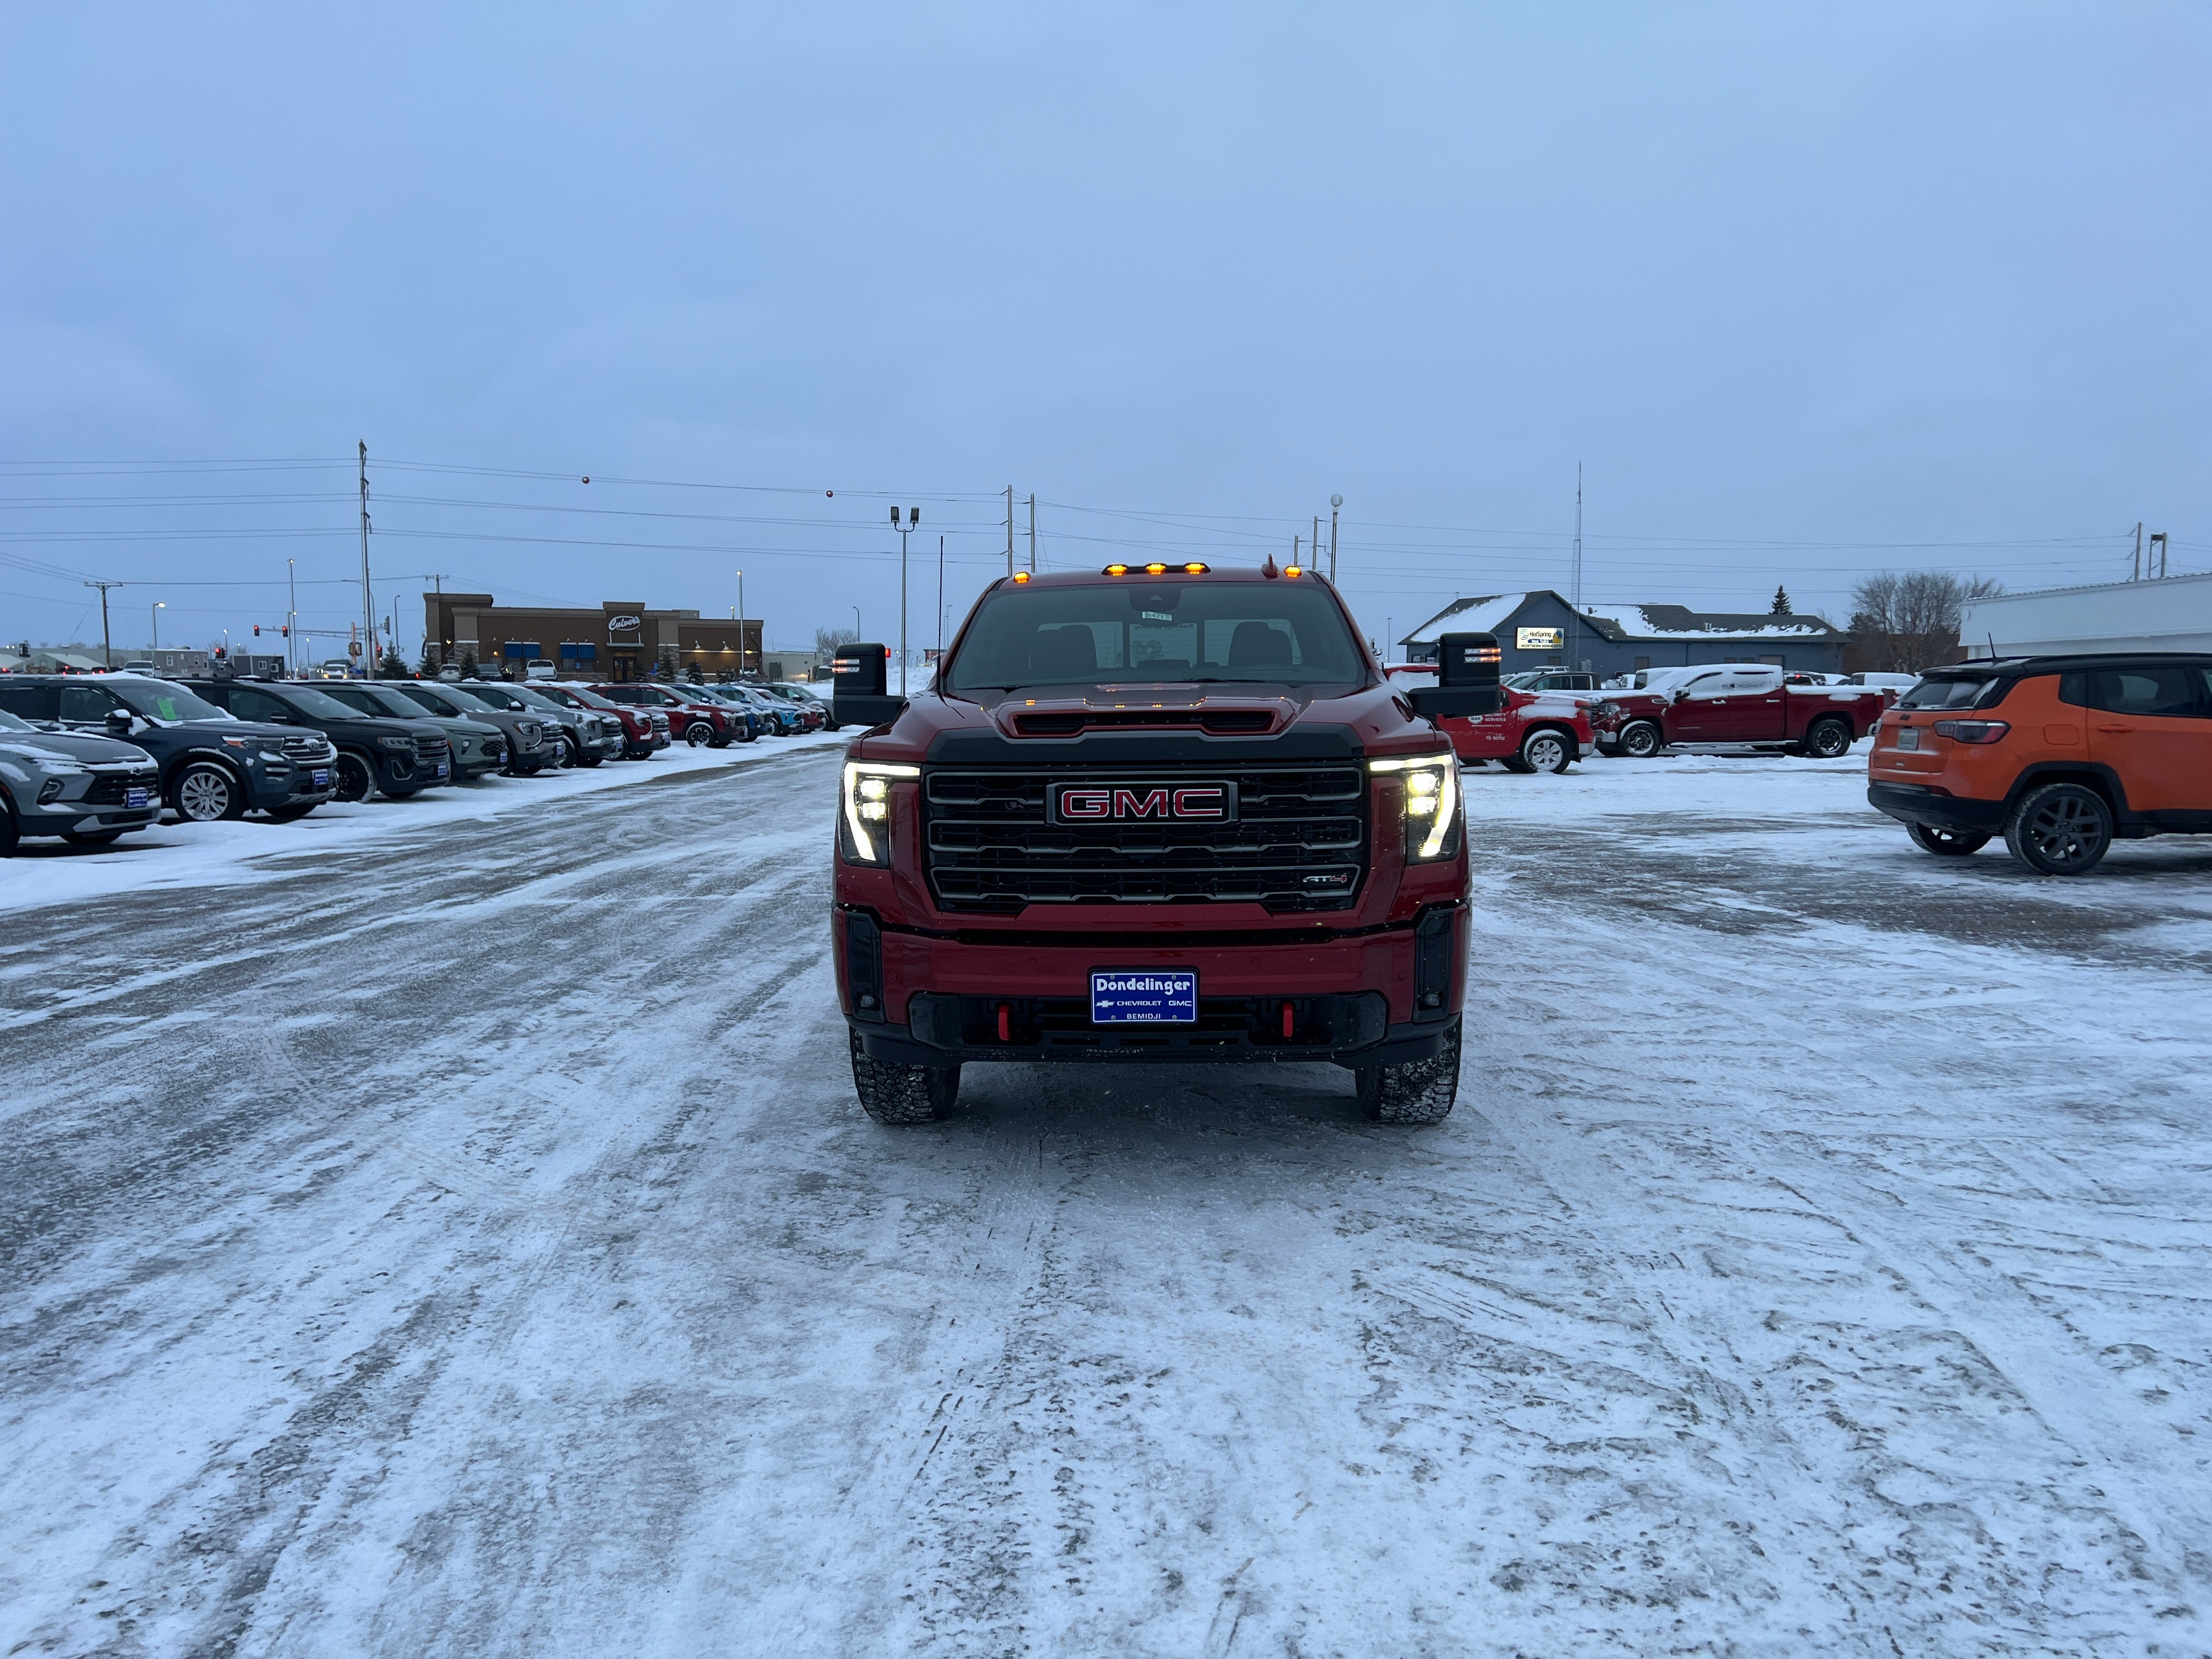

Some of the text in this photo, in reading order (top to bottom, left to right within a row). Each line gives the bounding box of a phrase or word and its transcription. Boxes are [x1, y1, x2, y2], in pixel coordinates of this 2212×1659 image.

[608, 616, 640, 630] Culver's
[1062, 789, 1222, 817] GMC
[1303, 874, 1347, 883] AT4
[1097, 978, 1190, 995] Dondelinger
